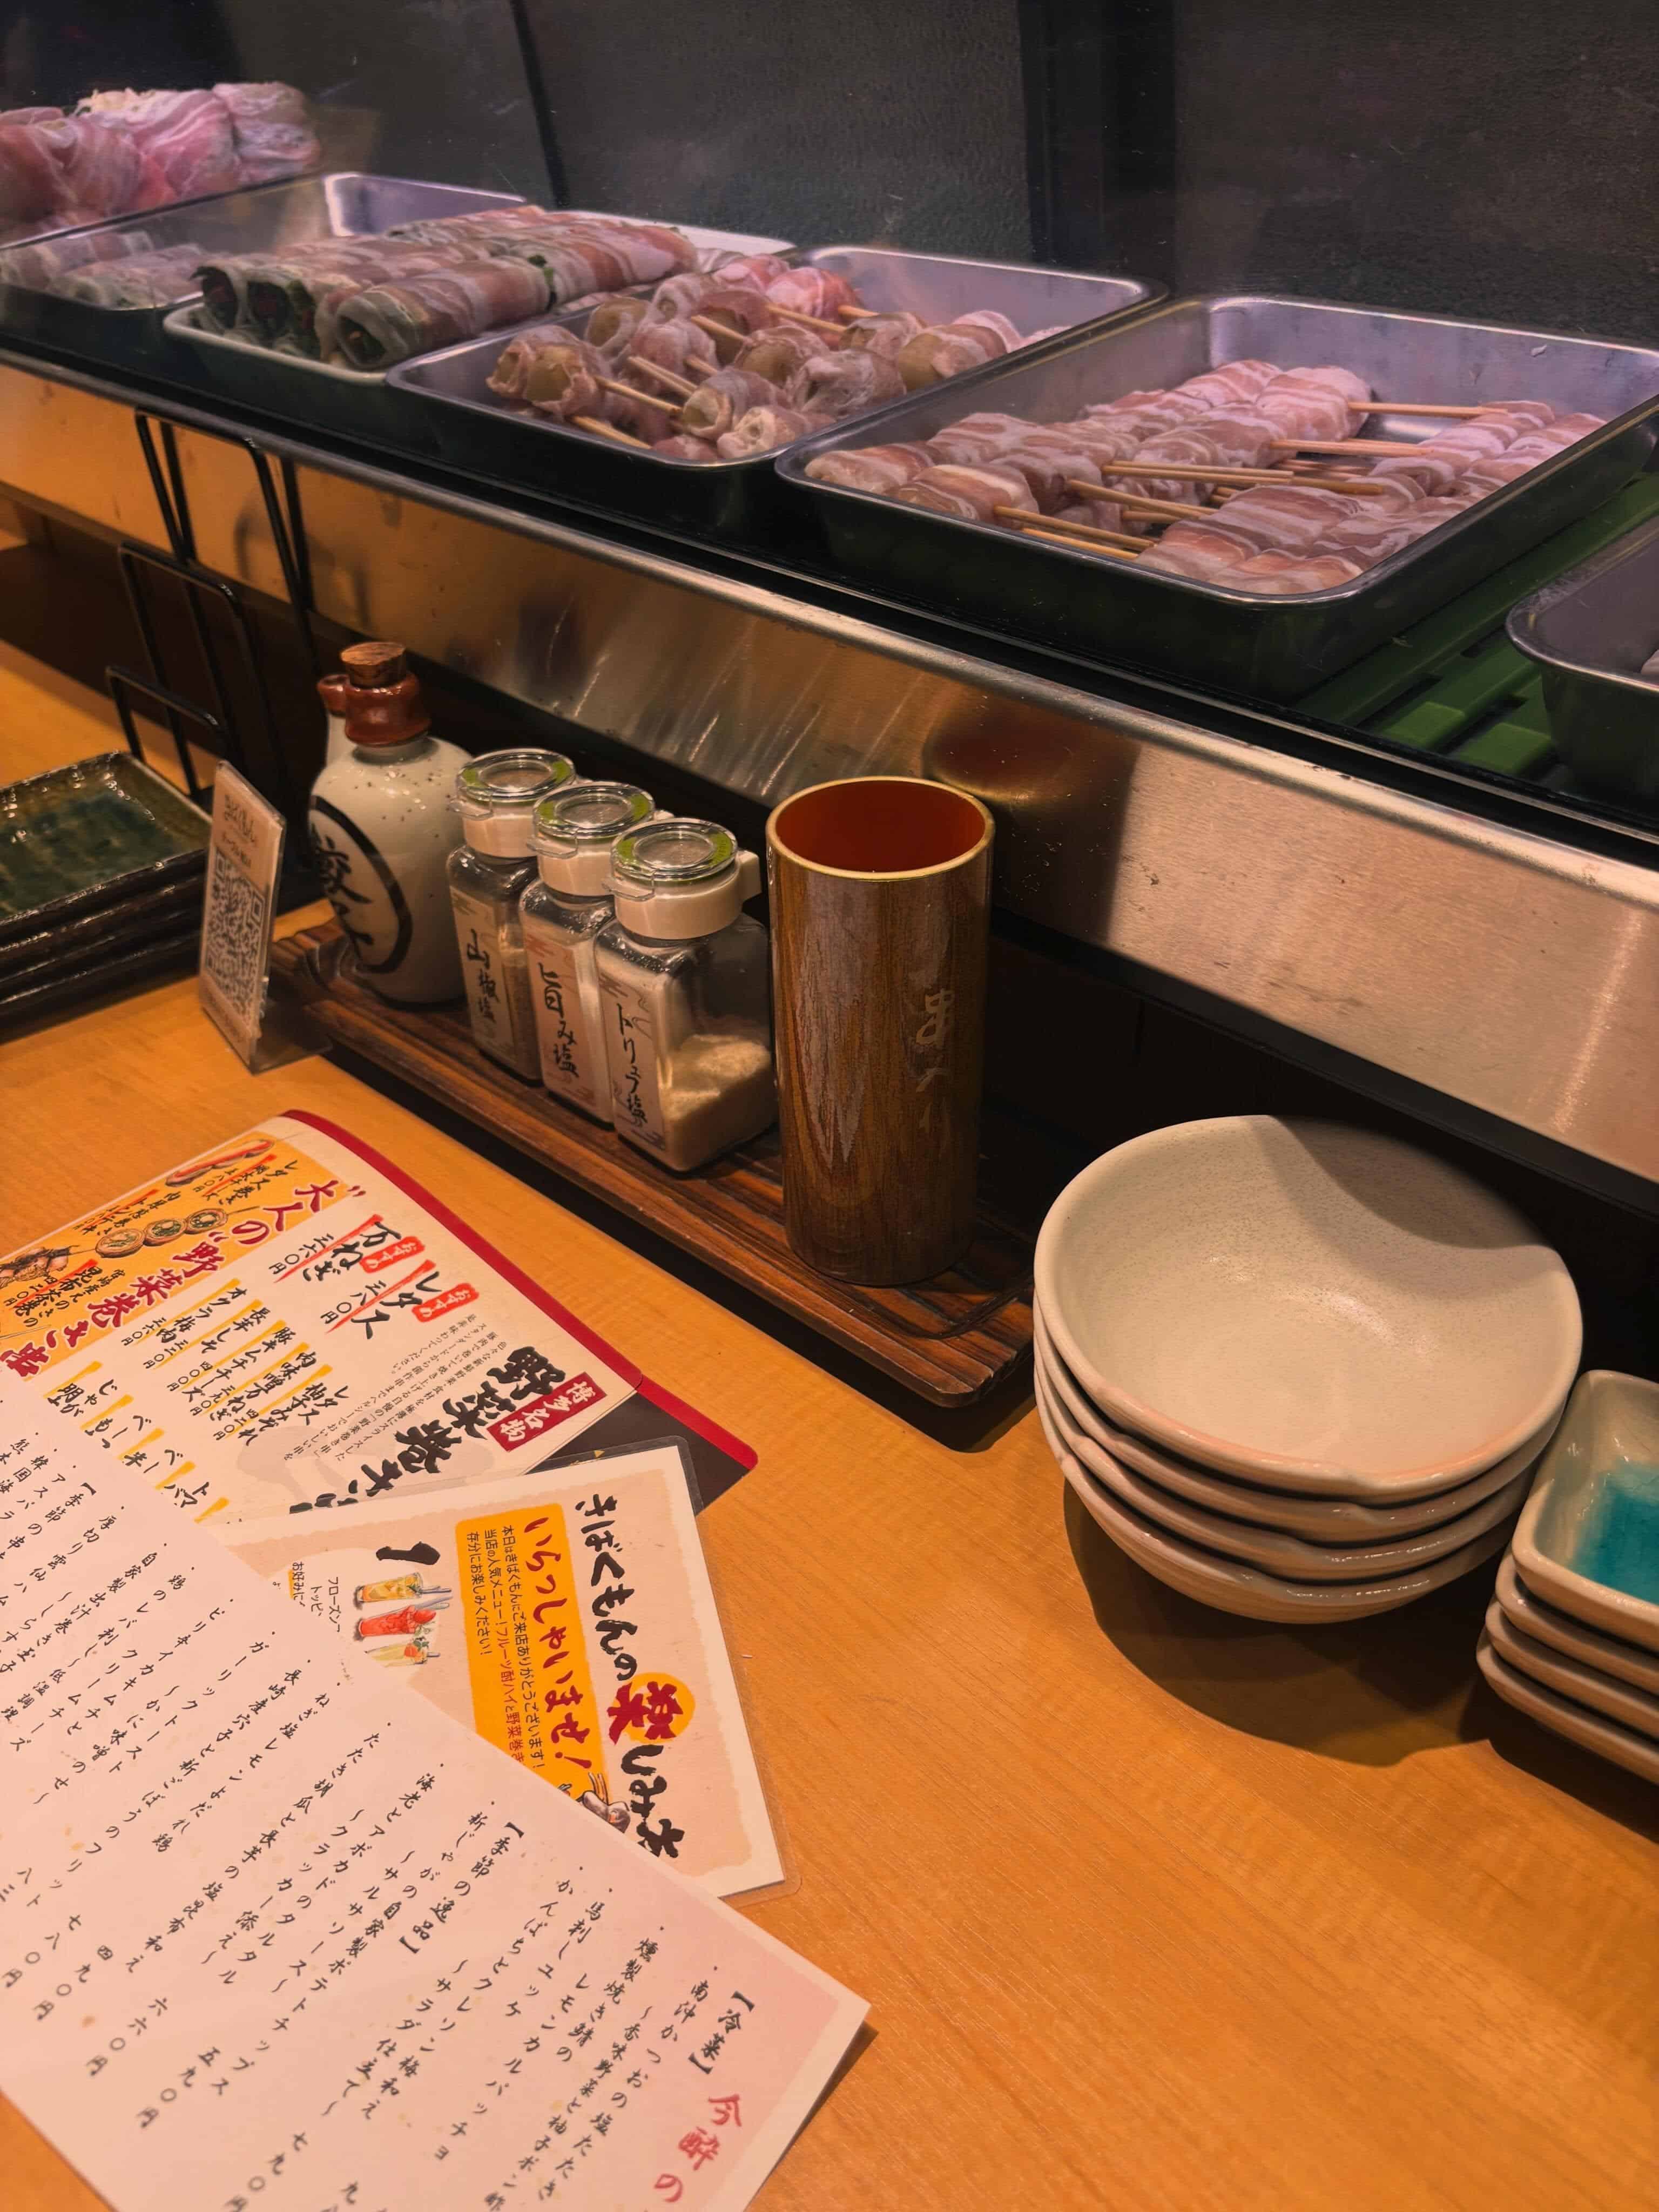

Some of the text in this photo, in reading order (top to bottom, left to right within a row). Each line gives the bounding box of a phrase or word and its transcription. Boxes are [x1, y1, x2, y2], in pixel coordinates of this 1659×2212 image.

[268, 1233, 334, 1274] 三六〇円
[303, 1222, 402, 1282] 万ねぎ
[146, 1287, 247, 1343] オクラ梅肉
[320, 1280, 386, 1324] 三八〇円
[350, 1271, 442, 1339] レタス
[181, 1327, 296, 1402] 豚キムチチーズ
[210, 1352, 316, 1421] 肉味噌万ねぎ
[298, 1386, 349, 1426] レタス
[501, 1382, 595, 1441] 博多名物
[293, 1562, 305, 1606] お好みに
[311, 1586, 323, 1616] トッピ
[467, 1532, 492, 1655] 存分にお楽しみください!
[502, 1525, 545, 1768] 本日はきばくもんにご来店ありがとうございます!
[524, 1518, 592, 1769] いらっしゃいませ!
[109, 1642, 269, 1772] ガーリックトースト
[27, 1669, 301, 1906] 長崎産穴子と新ごぼうのフリット
[152, 1694, 329, 1852] ねぎ塩レモンよだれ鶏
[126, 1733, 379, 1973] たたき胡瓜と長芋の塩昆布和え
[220, 1773, 435, 1984] 海老とアボカドのタルタル
[399, 1822, 524, 1954] 【季節の逸品】
[212, 1812, 488, 2095] 新じゃがの自家製ポテトチップス
[505, 1901, 605, 2017] 馬刺しユッケ
[688, 1991, 754, 2074] 【冷菜】
[654, 2094, 741, 2203] 今酔の
